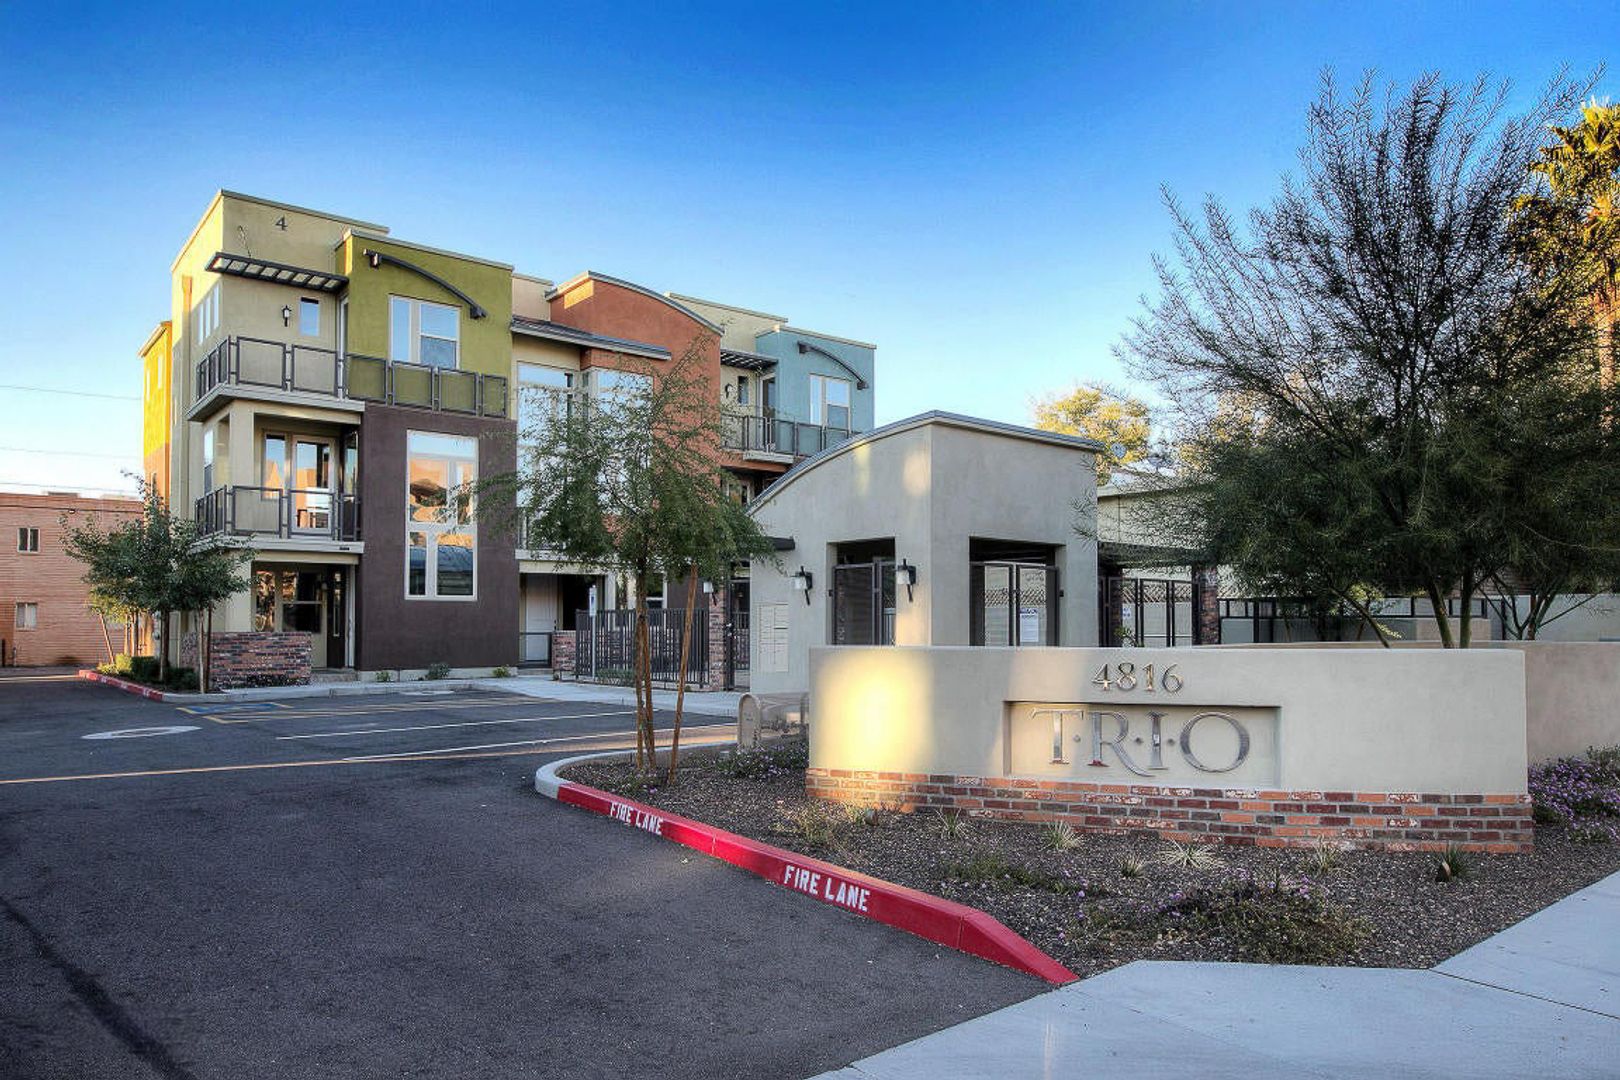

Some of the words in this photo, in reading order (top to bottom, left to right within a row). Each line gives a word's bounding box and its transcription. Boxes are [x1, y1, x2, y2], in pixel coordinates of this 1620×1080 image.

[1092, 662, 1184, 693] 4816
[609, 801, 632, 824] FIRE
[635, 810, 663, 836] LANE
[783, 864, 819, 895] FIRE
[823, 876, 871, 912] LANE
